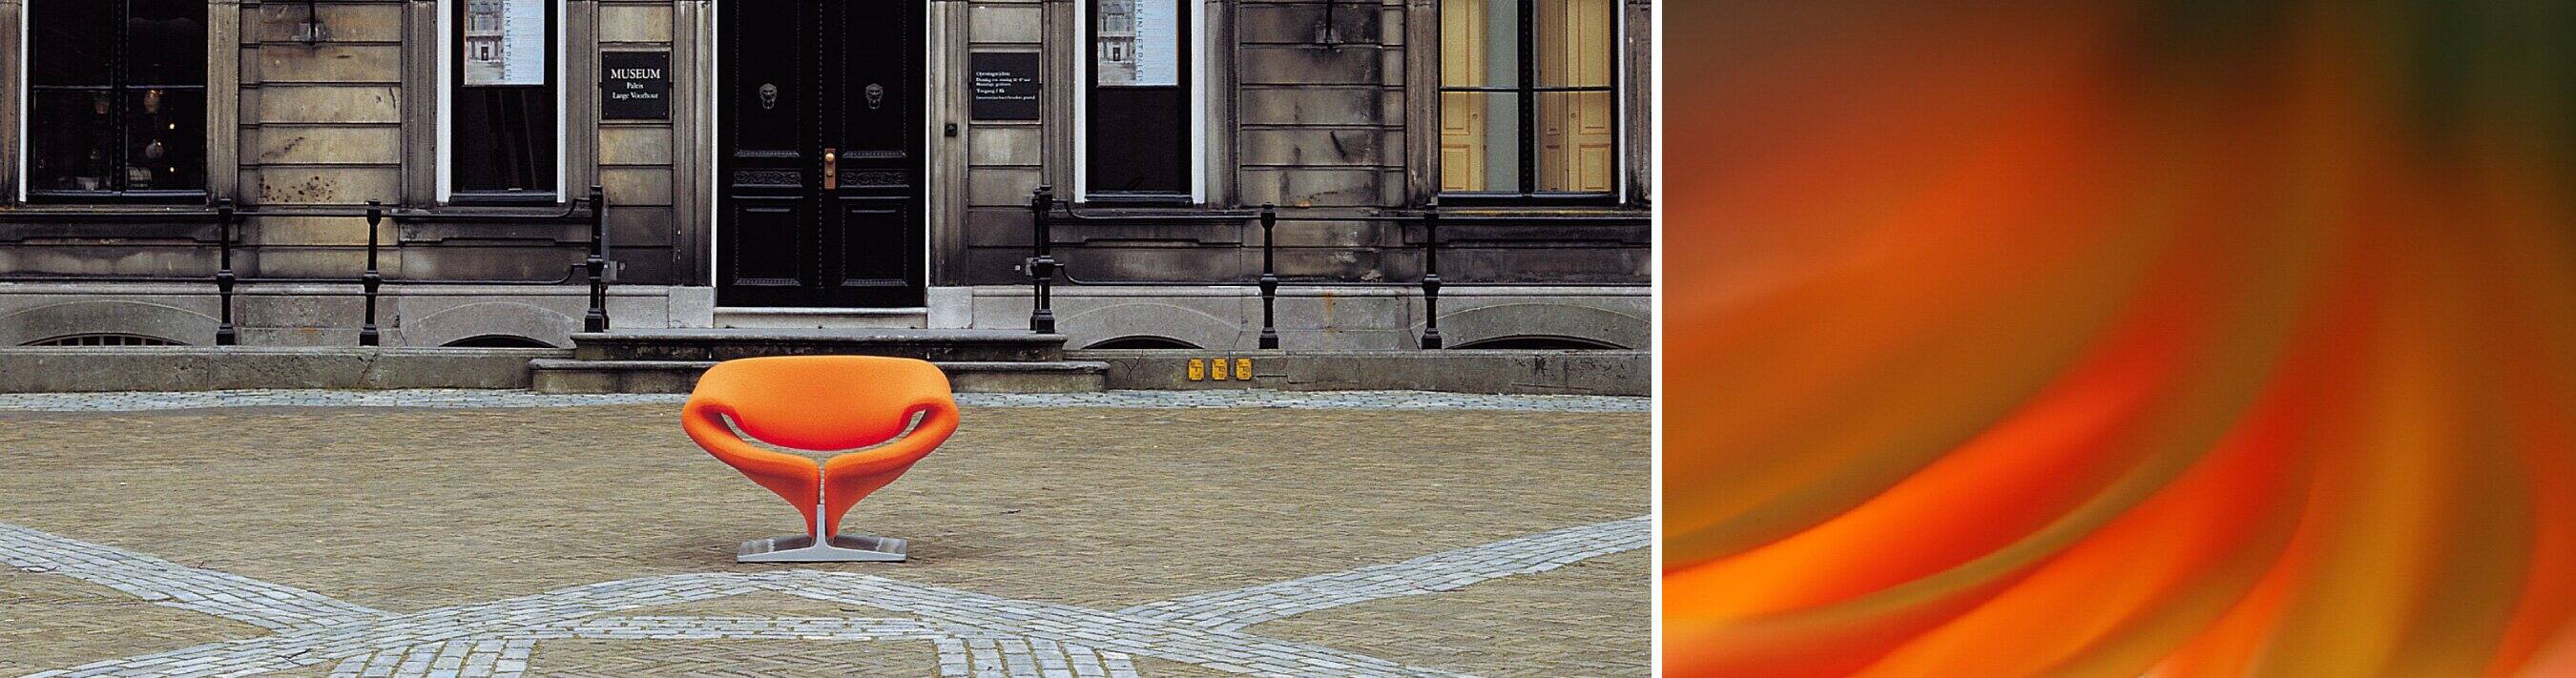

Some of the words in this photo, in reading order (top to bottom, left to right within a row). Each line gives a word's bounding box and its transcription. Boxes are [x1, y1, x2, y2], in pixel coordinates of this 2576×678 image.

[504, 16, 511, 26] IN
[1136, 17, 1143, 28] IN
[611, 68, 661, 79] MUSEUM
[613, 92, 630, 100] Lange
